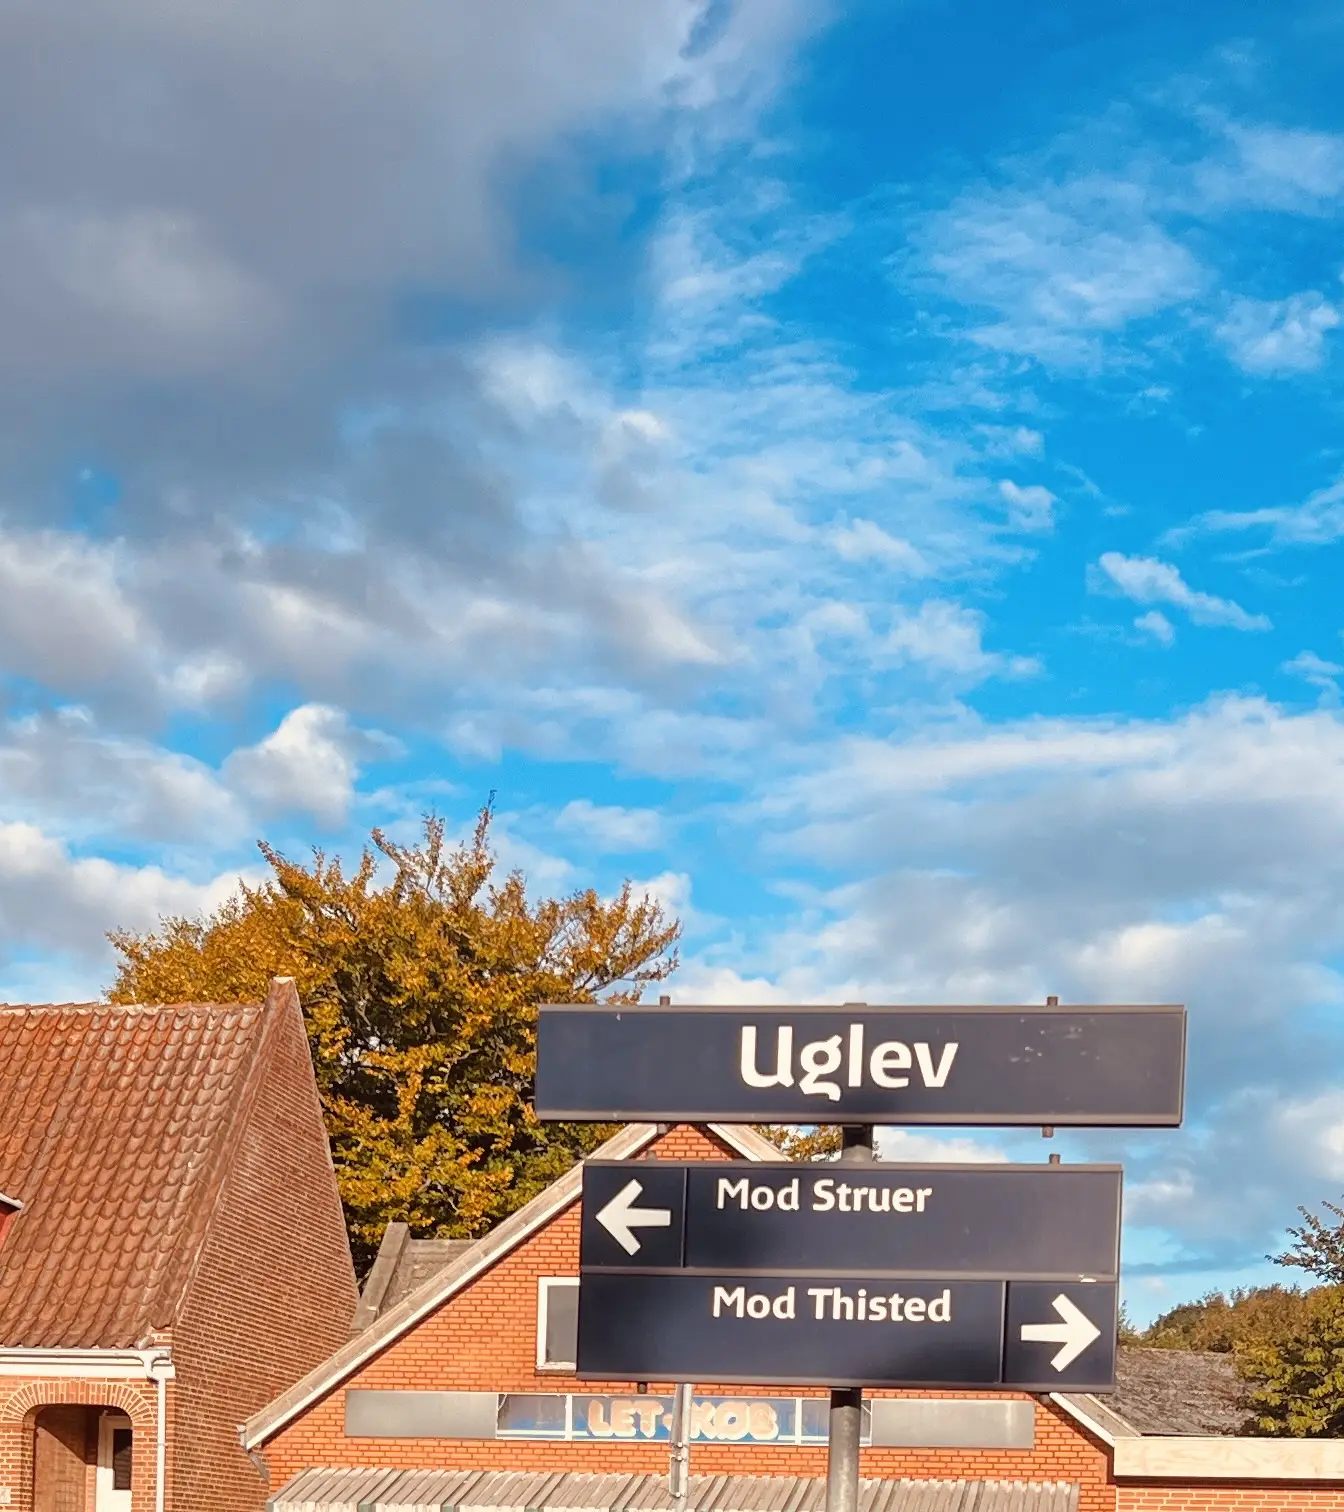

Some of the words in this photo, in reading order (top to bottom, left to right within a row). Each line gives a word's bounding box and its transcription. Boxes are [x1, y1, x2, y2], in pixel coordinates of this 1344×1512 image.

[740, 1024, 958, 1101] Uglev
[716, 1177, 799, 1211] Mod
[812, 1180, 933, 1213] Struer
[712, 1286, 796, 1319] Mod
[807, 1288, 952, 1322] Thisted
